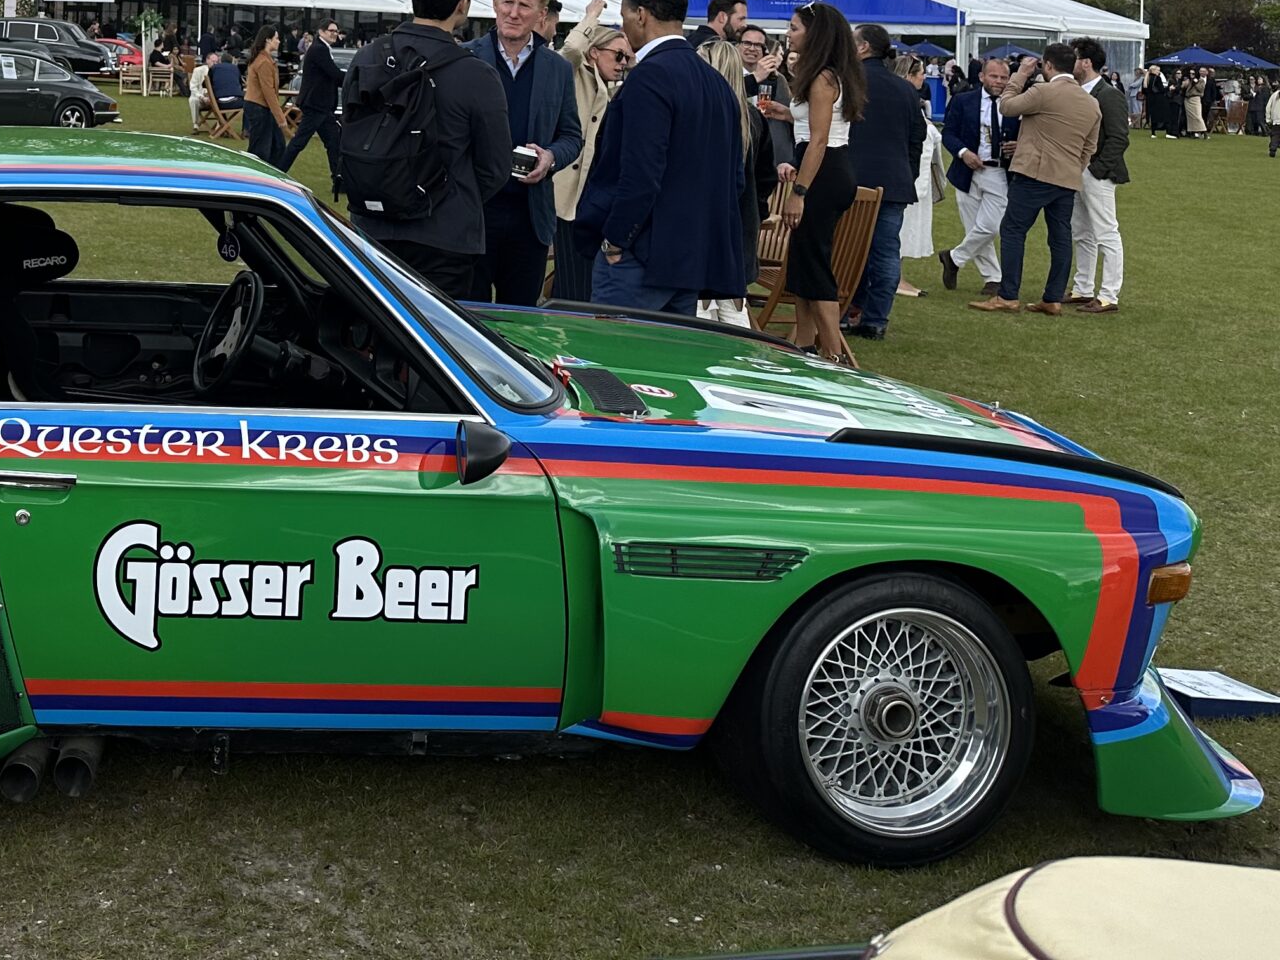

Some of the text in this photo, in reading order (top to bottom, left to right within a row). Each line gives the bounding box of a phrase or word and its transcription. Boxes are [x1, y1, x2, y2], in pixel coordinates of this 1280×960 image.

[221, 243, 236, 258] 46
[23, 254, 67, 270] RECARO
[93, 519, 480, 652] Gösser Beer
